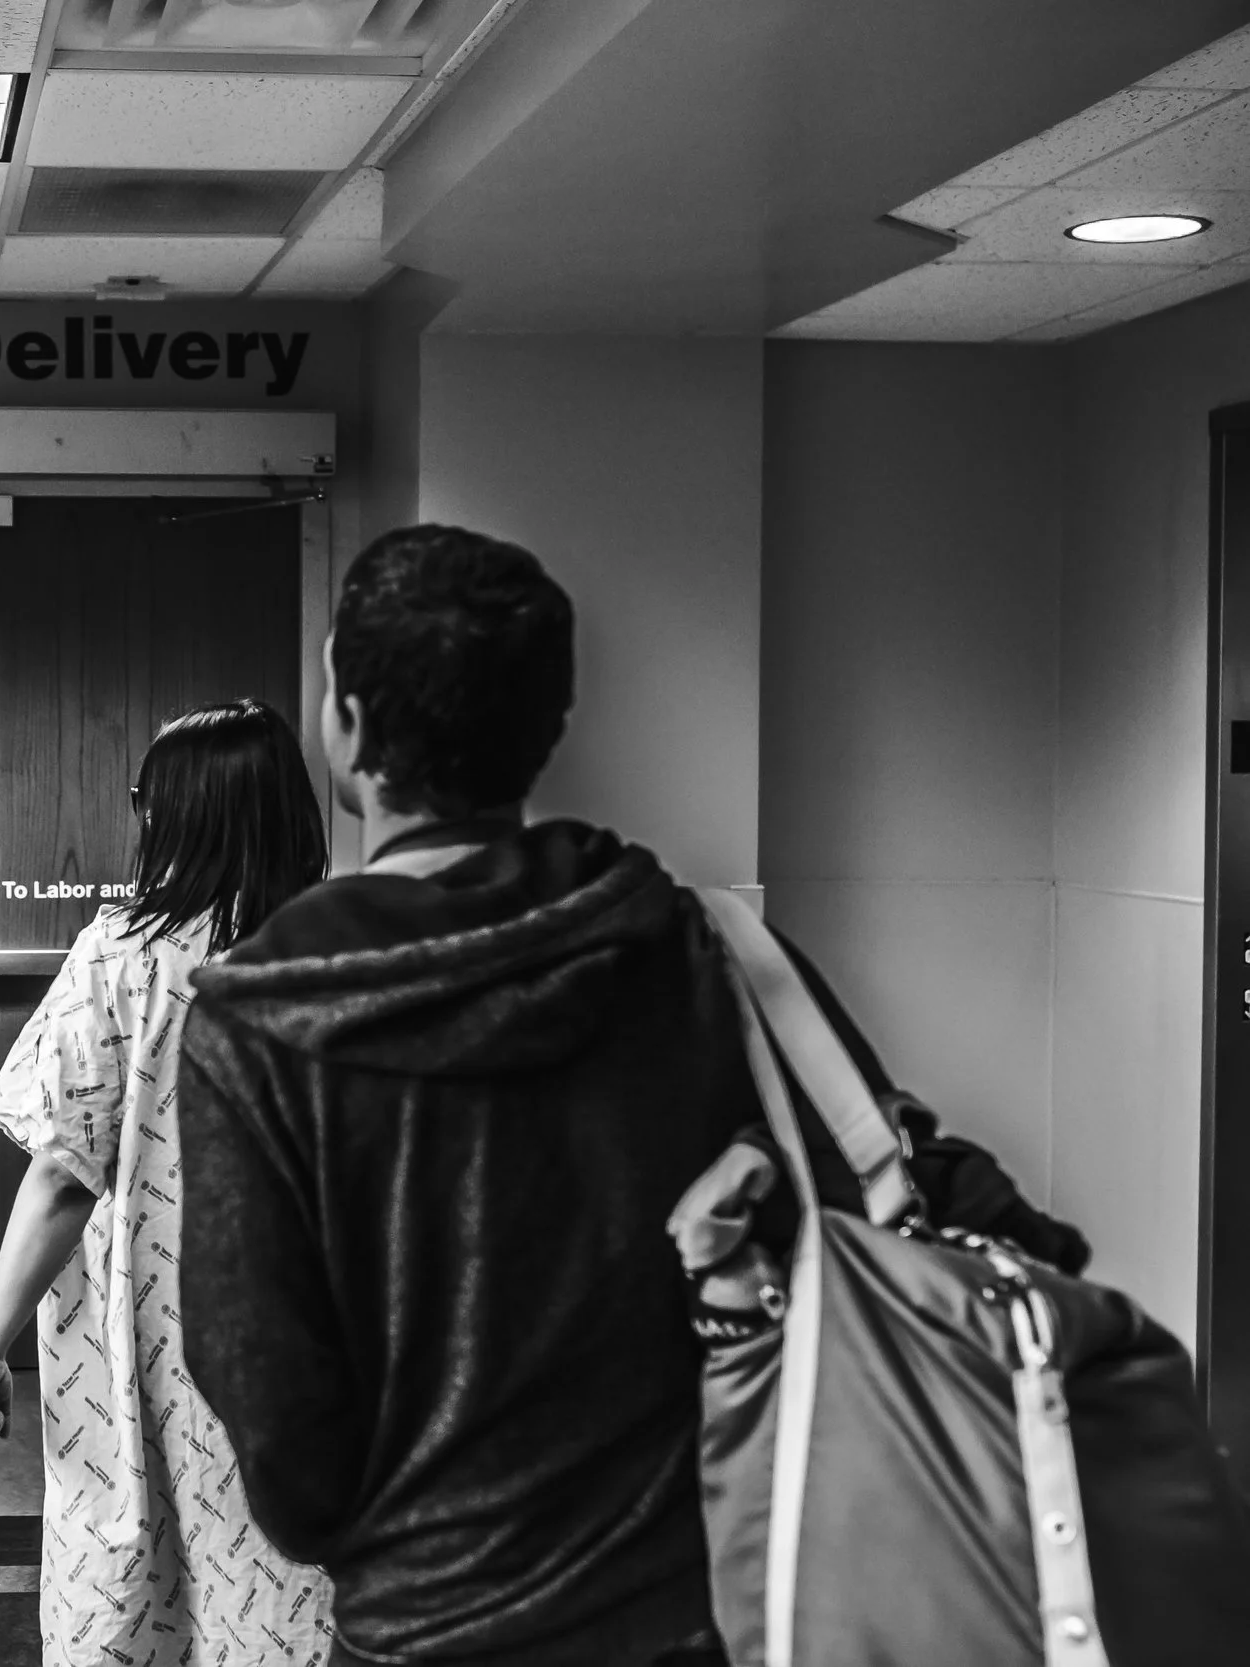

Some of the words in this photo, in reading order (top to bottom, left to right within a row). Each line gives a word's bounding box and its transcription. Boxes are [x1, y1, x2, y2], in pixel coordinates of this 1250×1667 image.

[1, 880, 28, 899] To
[33, 880, 95, 899] Labor
[99, 879, 137, 898] and
